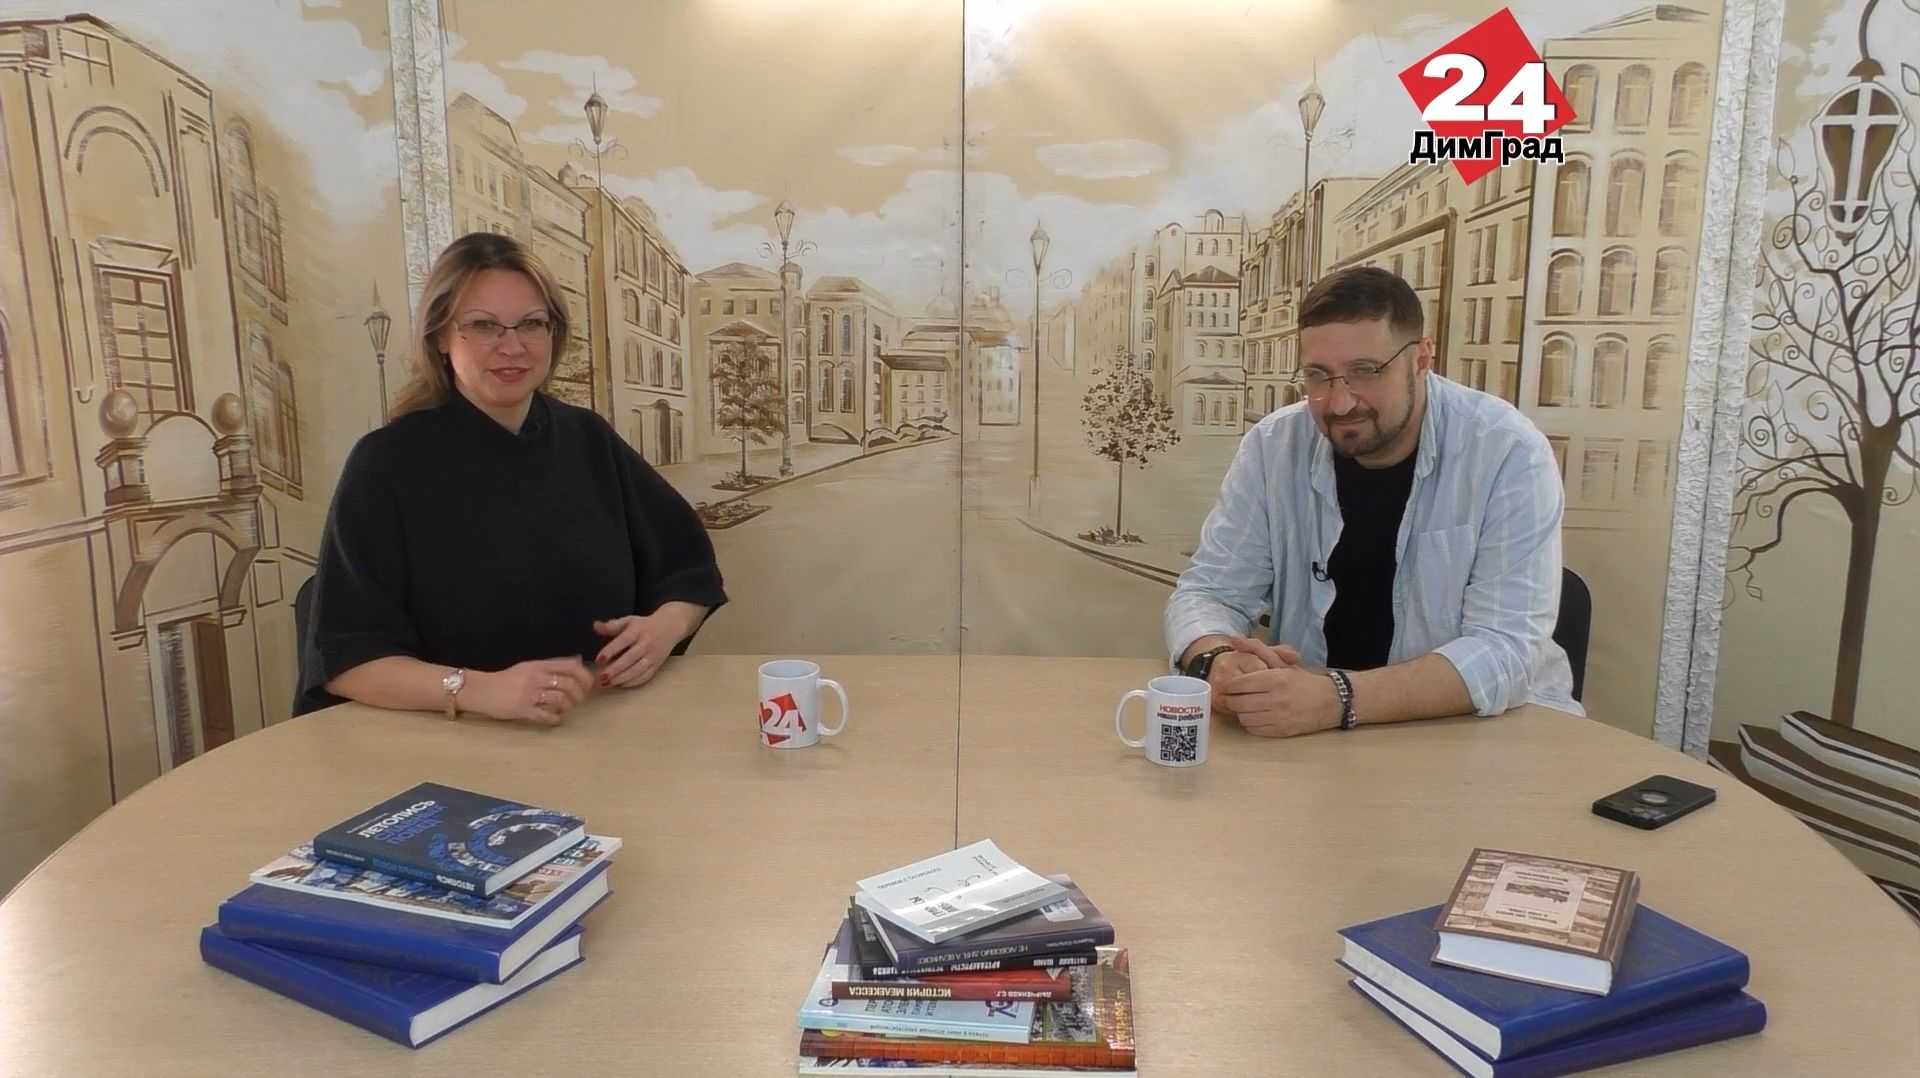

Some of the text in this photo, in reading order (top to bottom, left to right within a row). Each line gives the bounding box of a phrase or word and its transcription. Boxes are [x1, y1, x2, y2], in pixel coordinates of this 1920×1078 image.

[760, 700, 803, 736] 24
[1157, 712, 1204, 722] наша работа
[358, 800, 436, 838] ЛЕТОПИСЬ
[386, 819, 443, 845] ПОБЕД
[436, 874, 476, 892] ЛЕТОПИСЬ
[849, 986, 952, 997] ИСТОРИЯ МЕЛЕКЕССА
